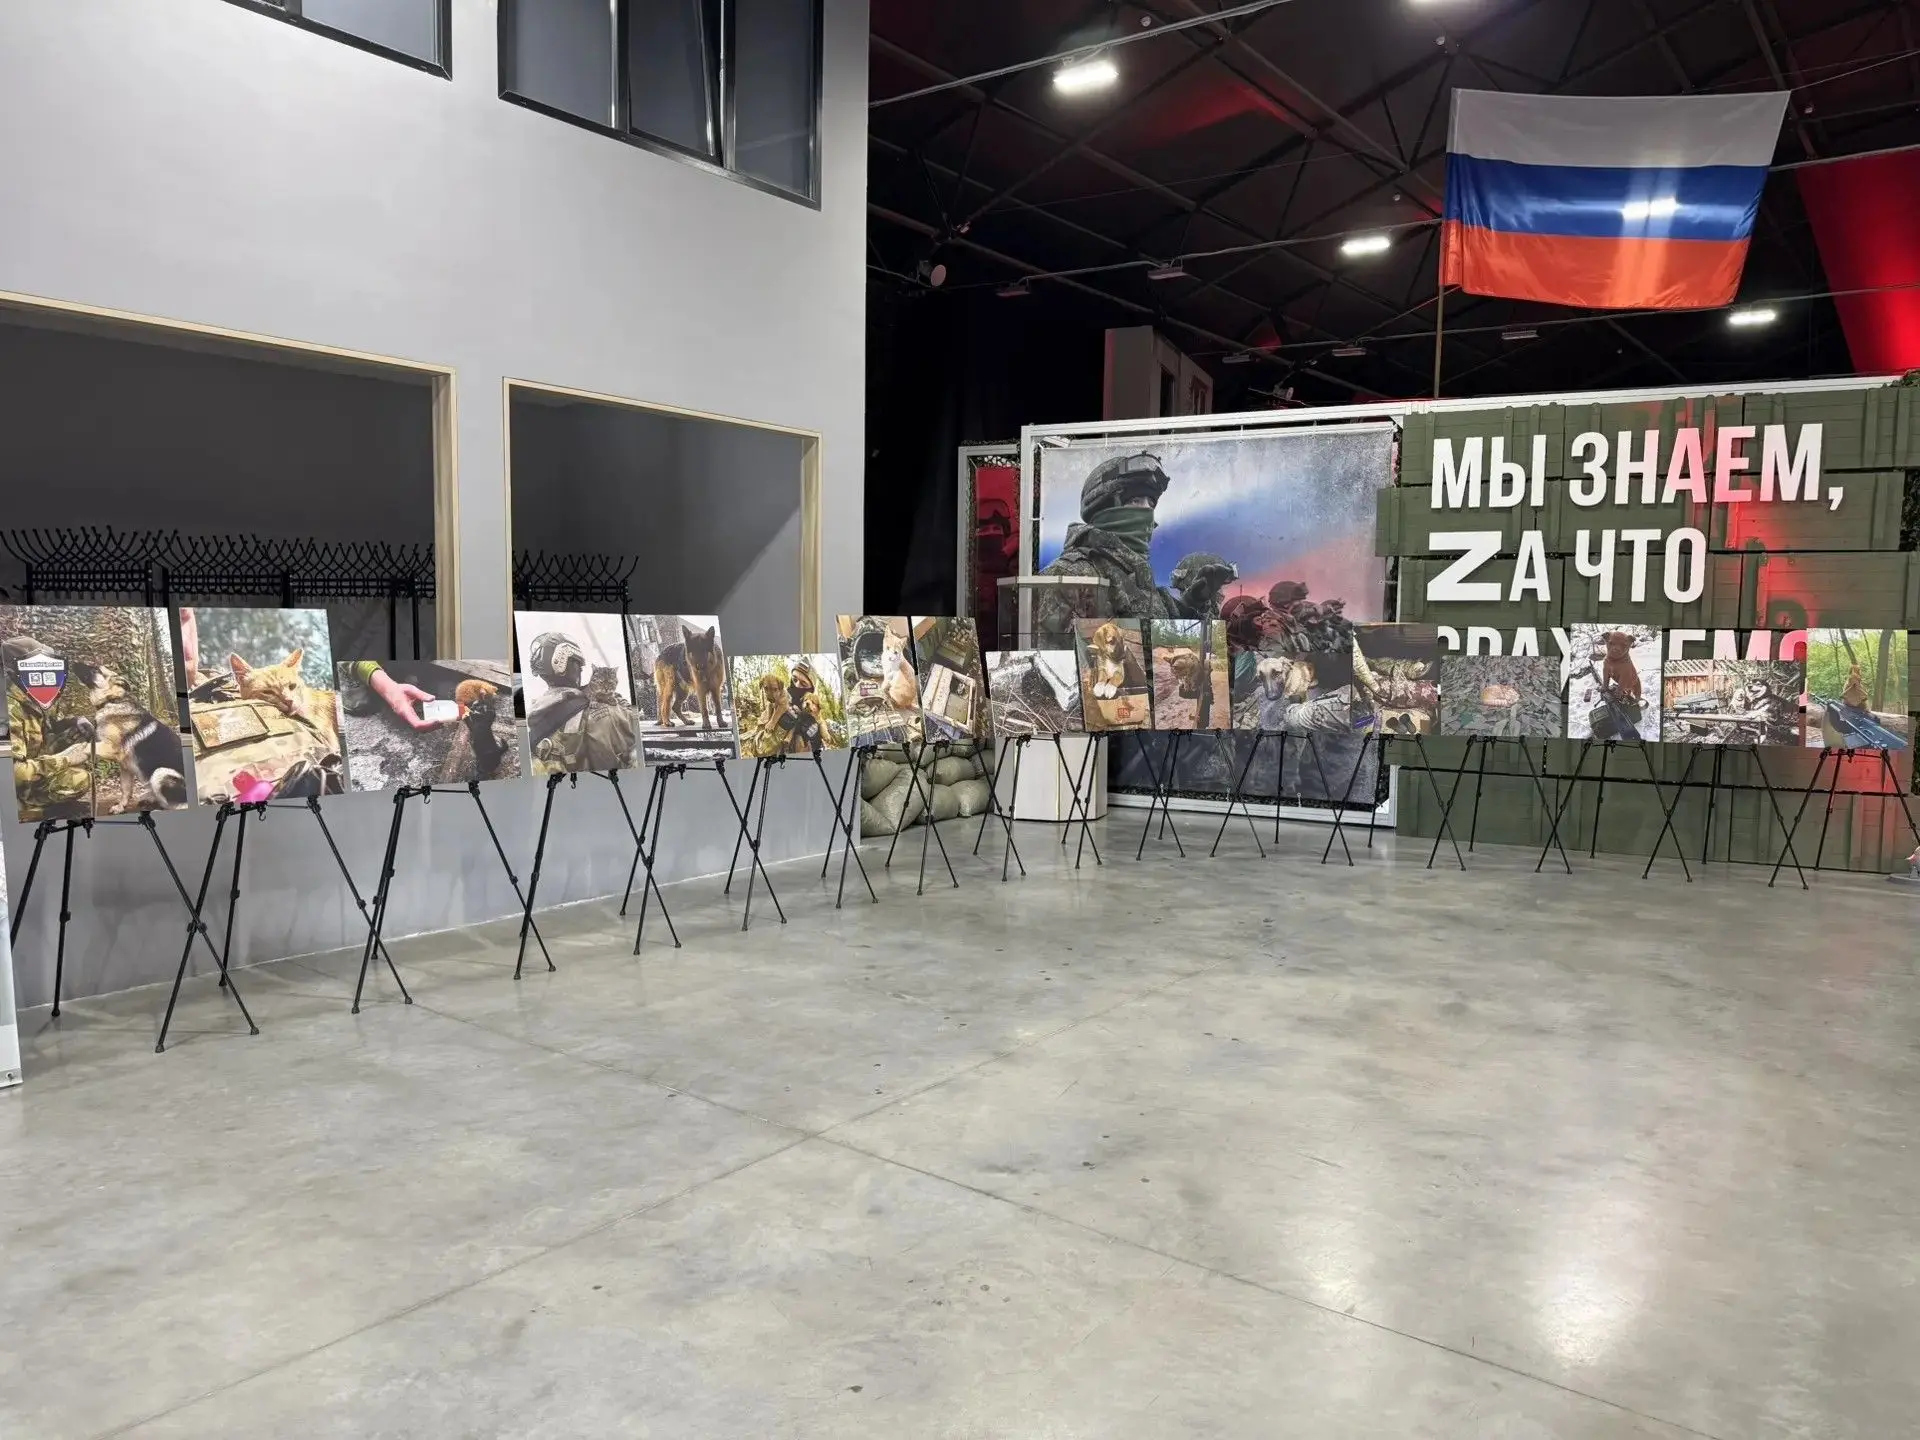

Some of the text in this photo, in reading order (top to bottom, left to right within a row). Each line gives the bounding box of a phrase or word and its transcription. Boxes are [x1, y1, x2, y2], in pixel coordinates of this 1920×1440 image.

[1431, 423, 1844, 511] МЫ ЗНАЕМ,
[1576, 527, 1707, 604] ЧТО
